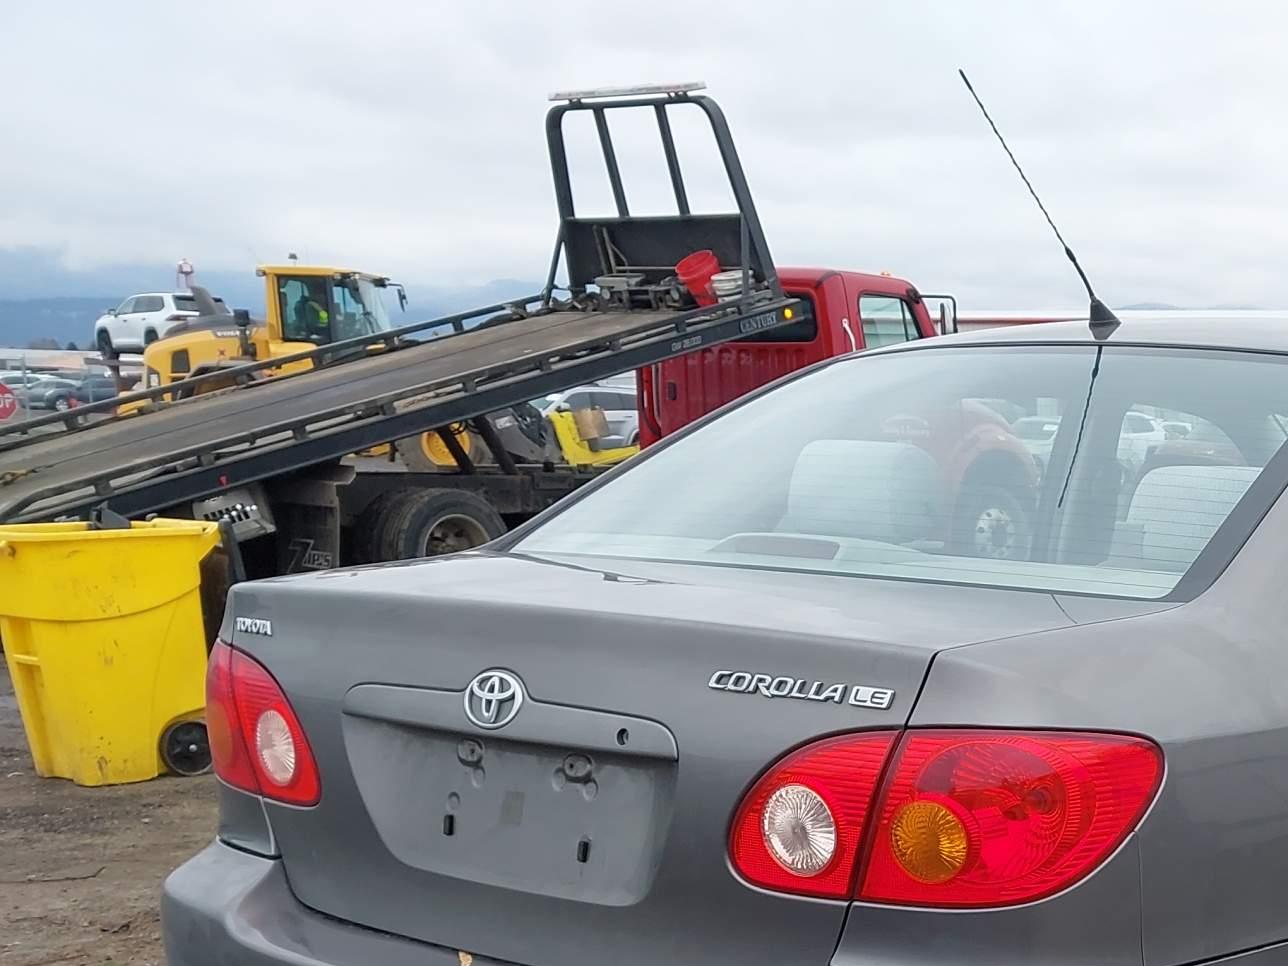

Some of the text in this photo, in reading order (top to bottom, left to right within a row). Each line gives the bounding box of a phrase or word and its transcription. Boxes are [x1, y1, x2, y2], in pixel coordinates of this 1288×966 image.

[740, 311, 777, 333] CENTURY
[236, 616, 273, 636] TOYOTA
[708, 670, 894, 709] COROLLA LE
